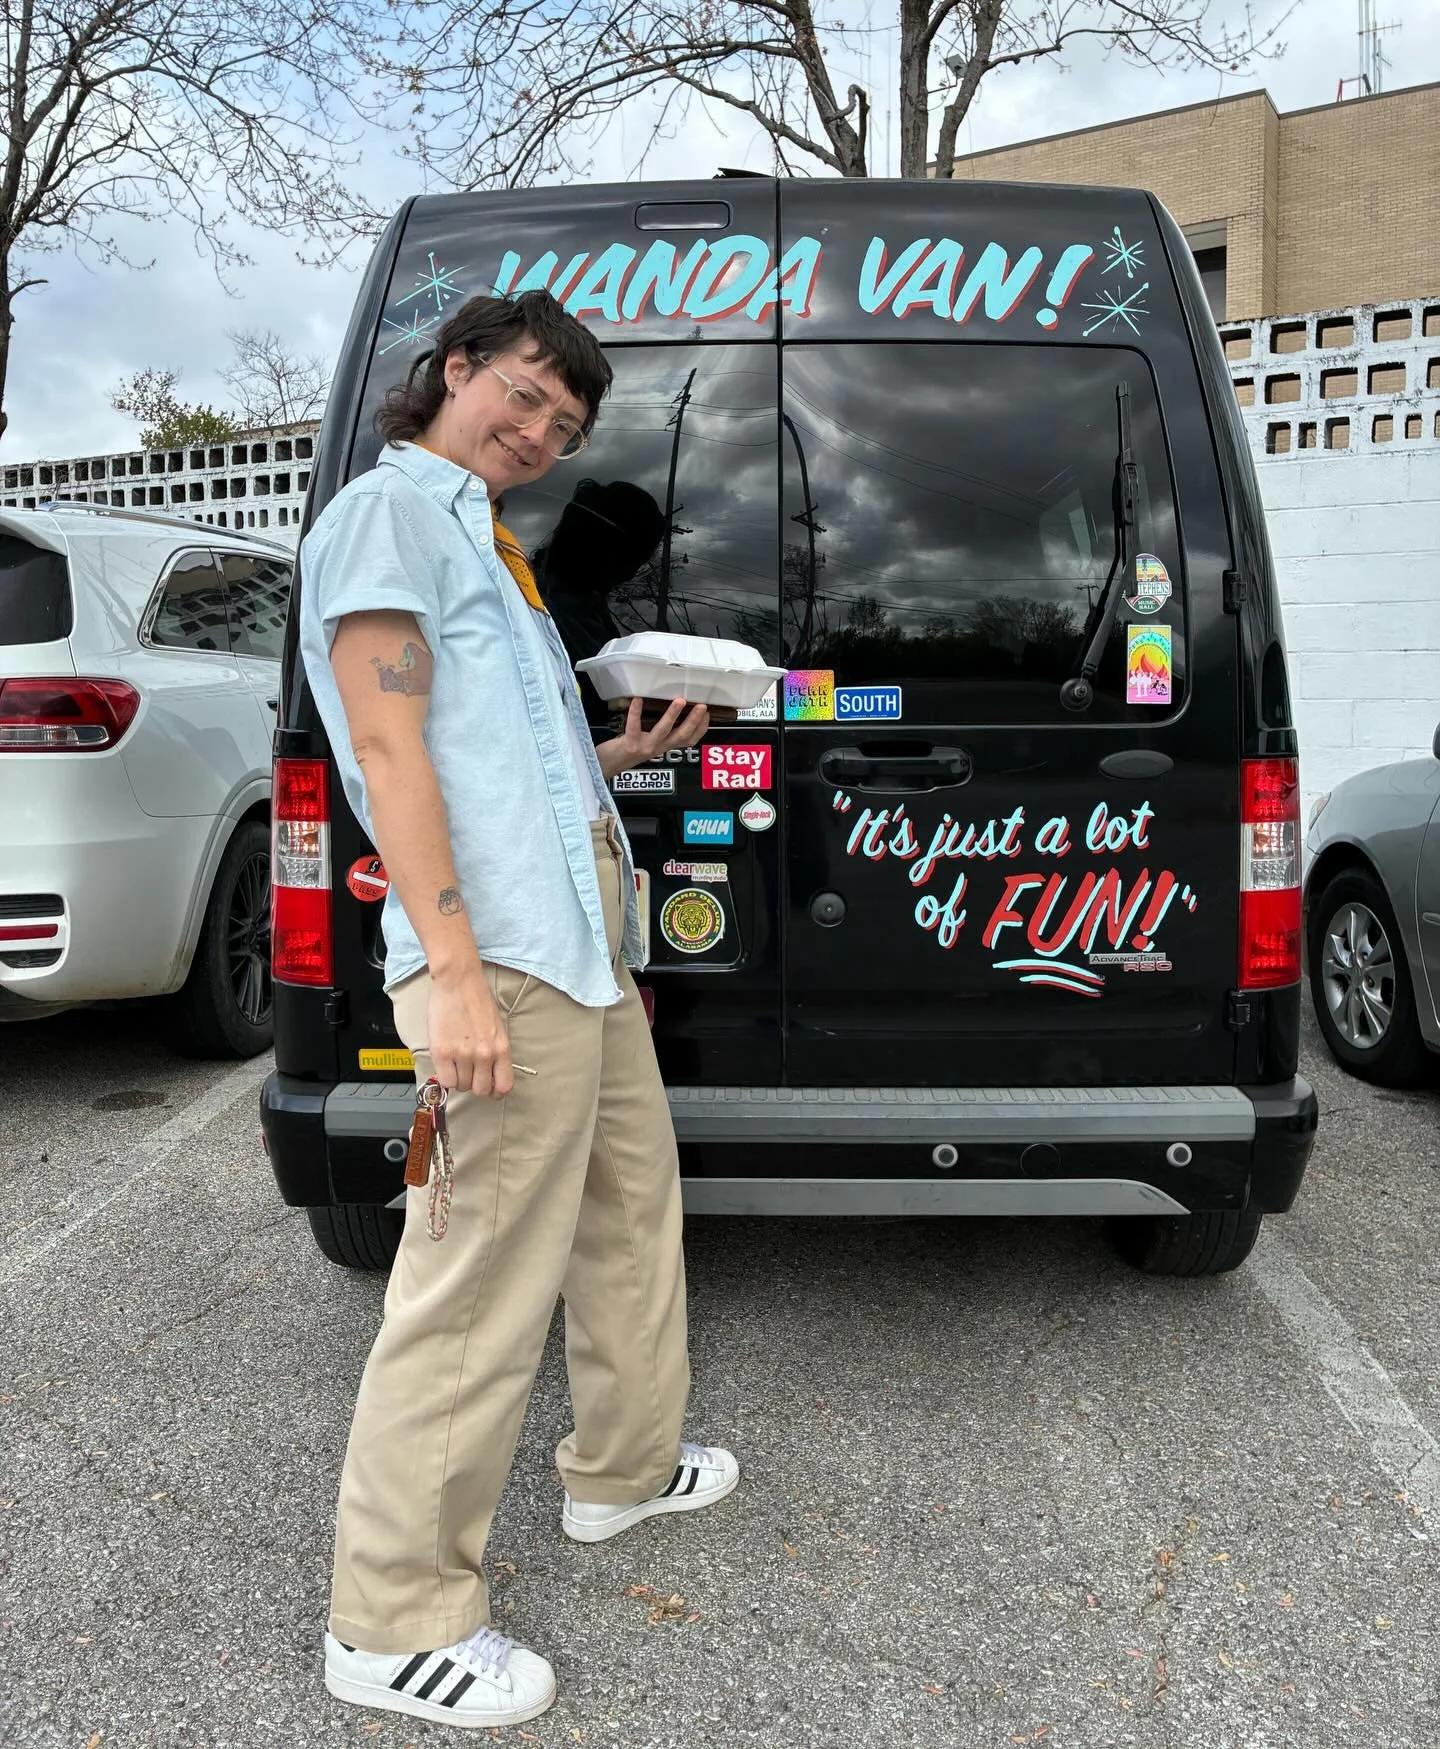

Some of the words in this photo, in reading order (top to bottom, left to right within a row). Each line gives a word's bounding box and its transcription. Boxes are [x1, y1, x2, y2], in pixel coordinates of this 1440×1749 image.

[490, 234, 821, 326] WANDA
[858, 236, 1094, 331] VAN!
[1138, 582, 1169, 594] TEPHENS
[839, 693, 897, 713] SOUTH
[707, 746, 765, 769] Stay
[616, 772, 633, 782] 10
[638, 772, 670, 781] TON
[616, 781, 671, 789] RECORDS
[712, 769, 761, 788] Rad
[908, 805, 1025, 887] just
[1034, 815, 1072, 858] a
[1085, 800, 1155, 852] lot
[664, 860, 727, 875] clearwave
[664, 892, 697, 938] STANDARD
[700, 894, 721, 934] DELUXE
[914, 871, 968, 949] of
[675, 938, 713, 949] ALABAMA
[1123, 960, 1173, 972] RSC
[362, 1052, 416, 1066] mullina
